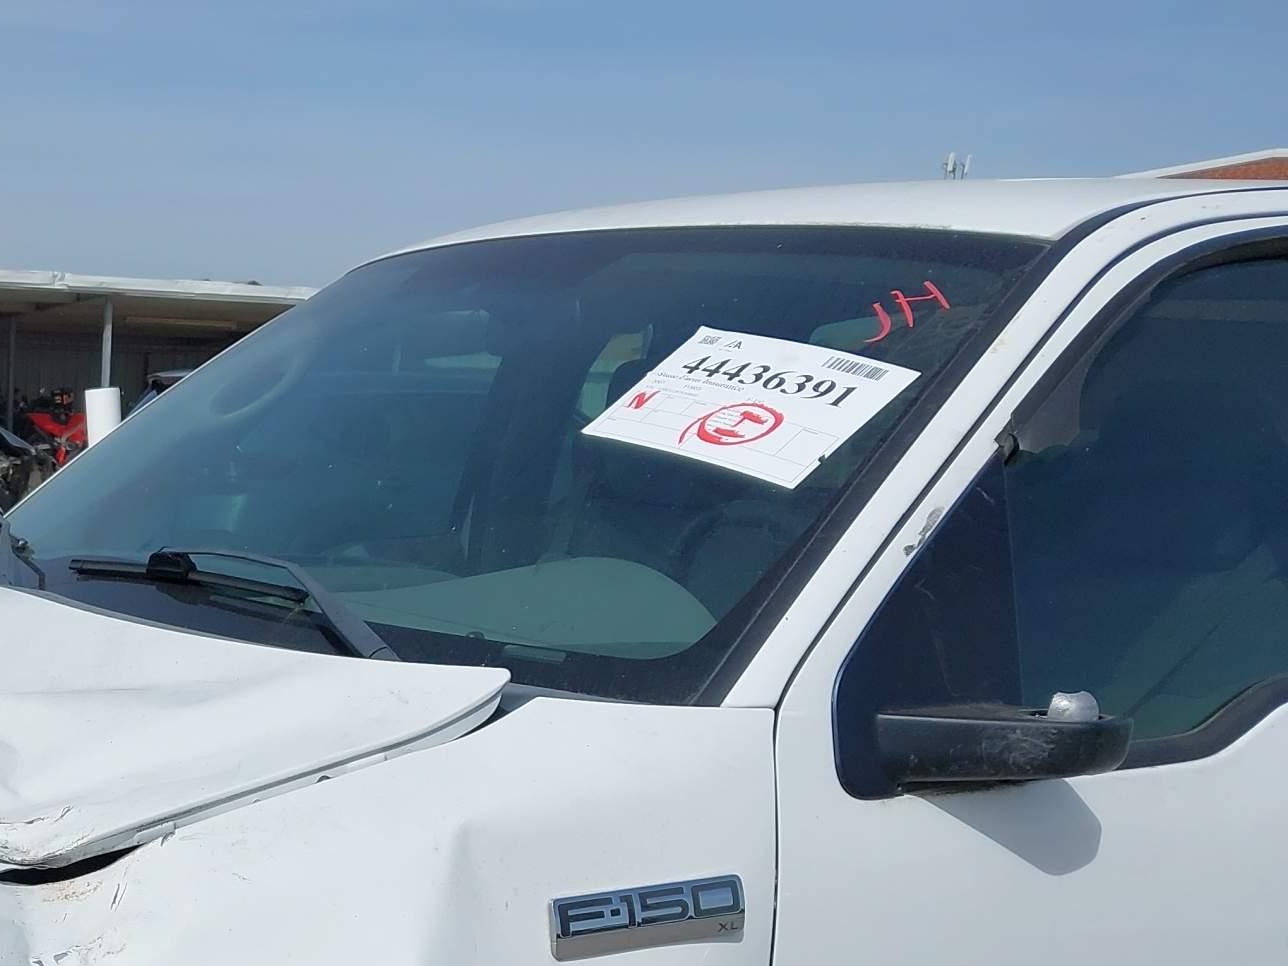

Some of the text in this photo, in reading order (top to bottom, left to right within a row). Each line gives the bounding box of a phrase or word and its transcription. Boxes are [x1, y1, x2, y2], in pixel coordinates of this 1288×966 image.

[627, 390, 662, 410] N
[681, 355, 858, 409] 44436391
[557, 879, 743, 938] F-150
[717, 922, 739, 933] XL
